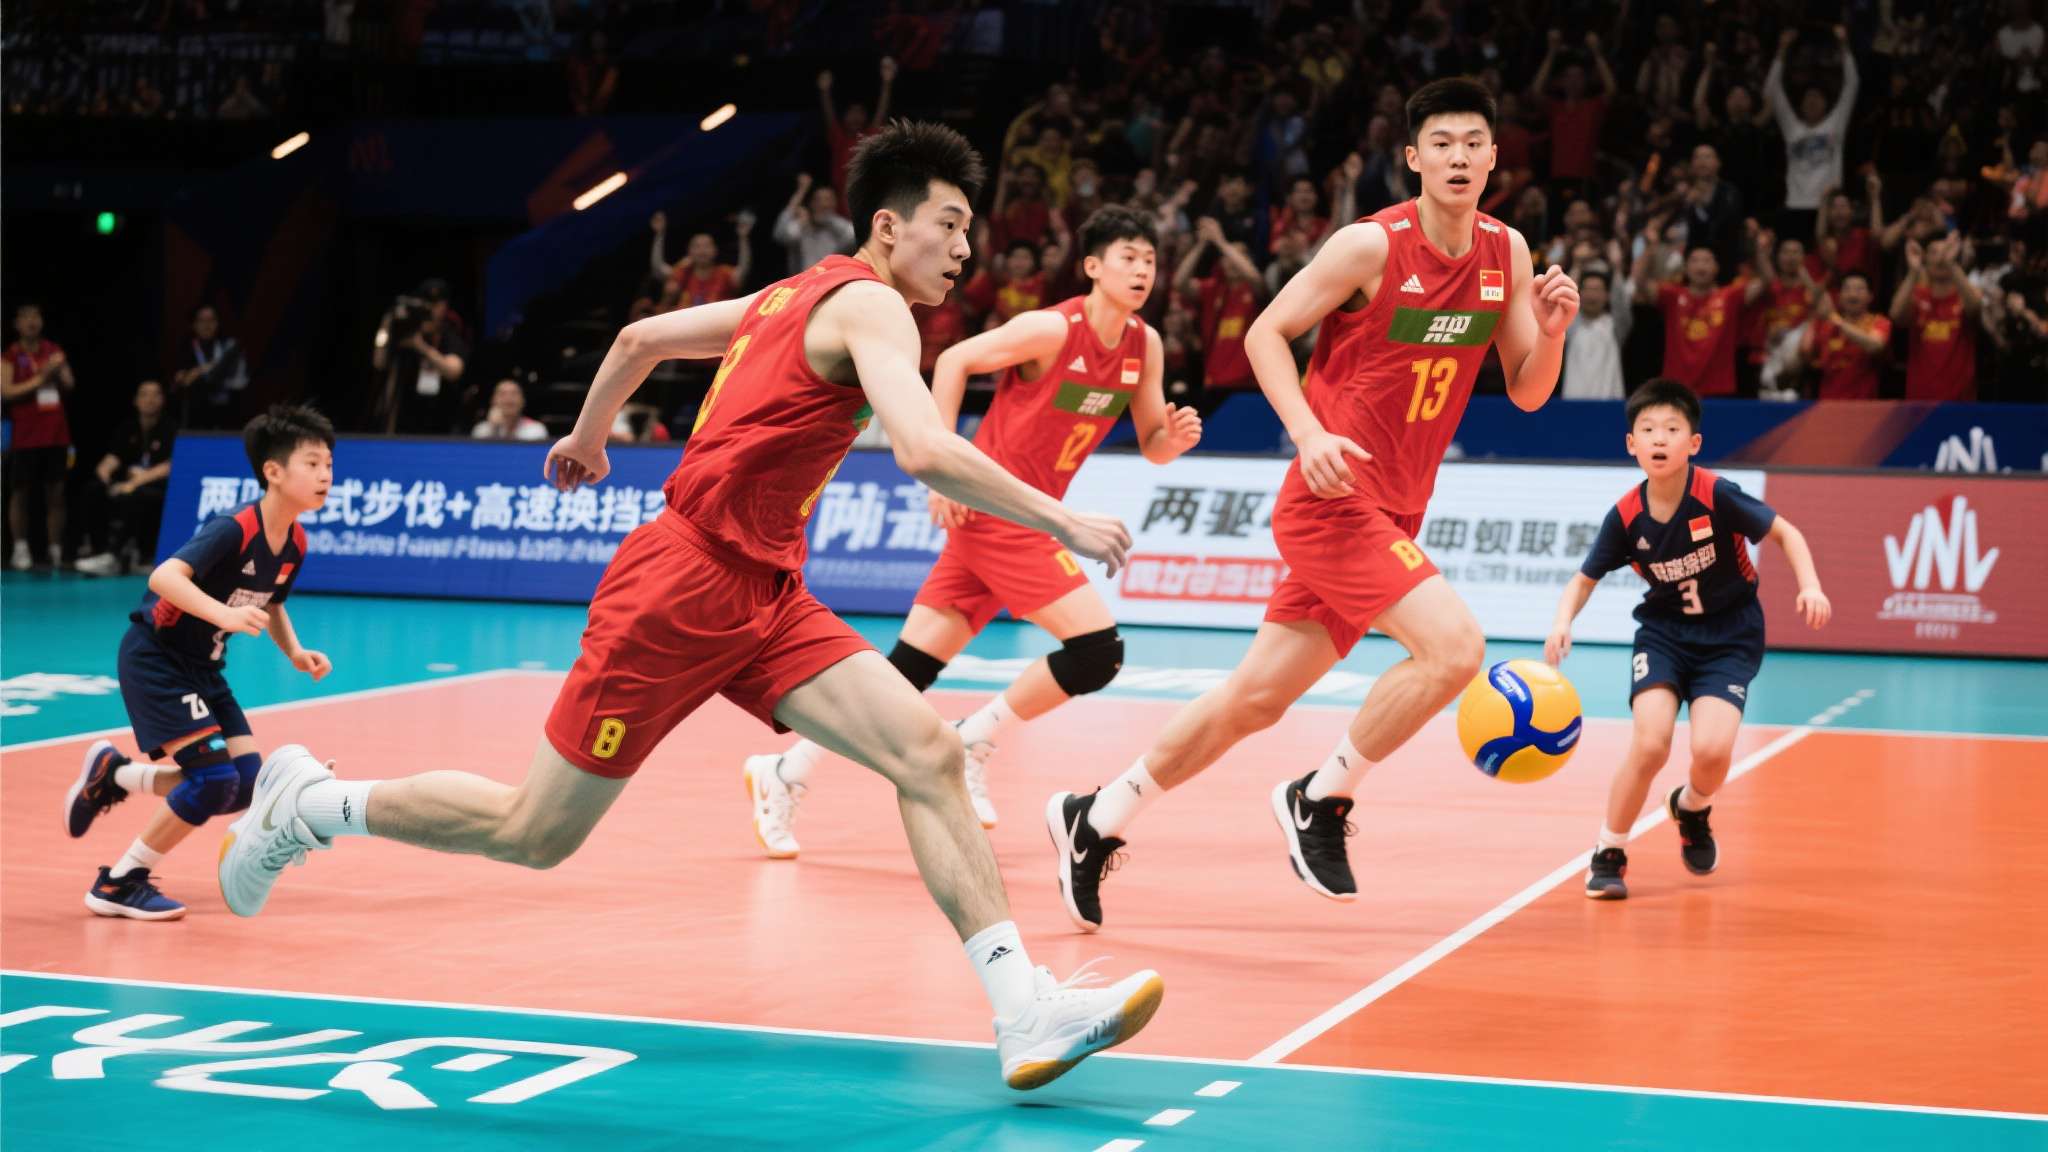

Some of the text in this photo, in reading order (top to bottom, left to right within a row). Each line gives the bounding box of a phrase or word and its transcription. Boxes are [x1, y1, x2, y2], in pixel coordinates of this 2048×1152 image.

[1406, 357, 1458, 423] 13
[1054, 422, 1097, 472] 12
[1140, 485, 1273, 538] 两驱
[1884, 495, 2000, 592] VNL
[1677, 578, 1704, 615] 3
